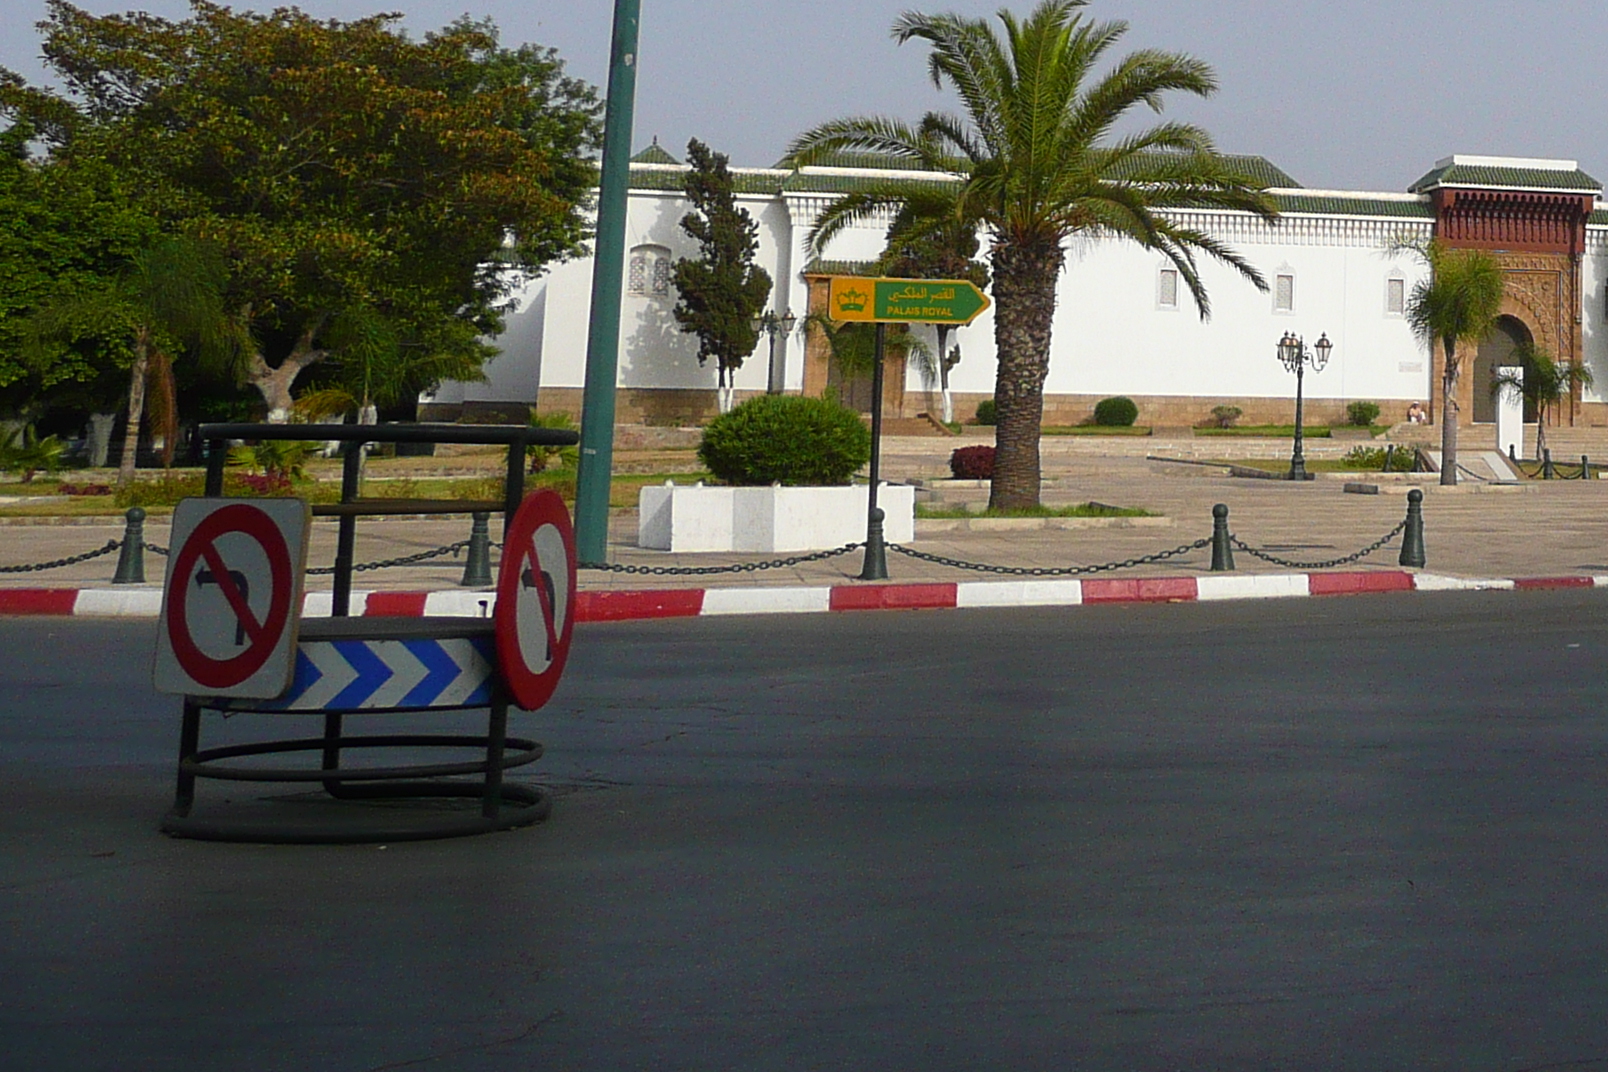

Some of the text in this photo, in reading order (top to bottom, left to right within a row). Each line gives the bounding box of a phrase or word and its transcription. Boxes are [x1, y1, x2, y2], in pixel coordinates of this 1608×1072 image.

[888, 286, 955, 303] القصر الملكي
[887, 306, 953, 317] PALAIS ROYAL
